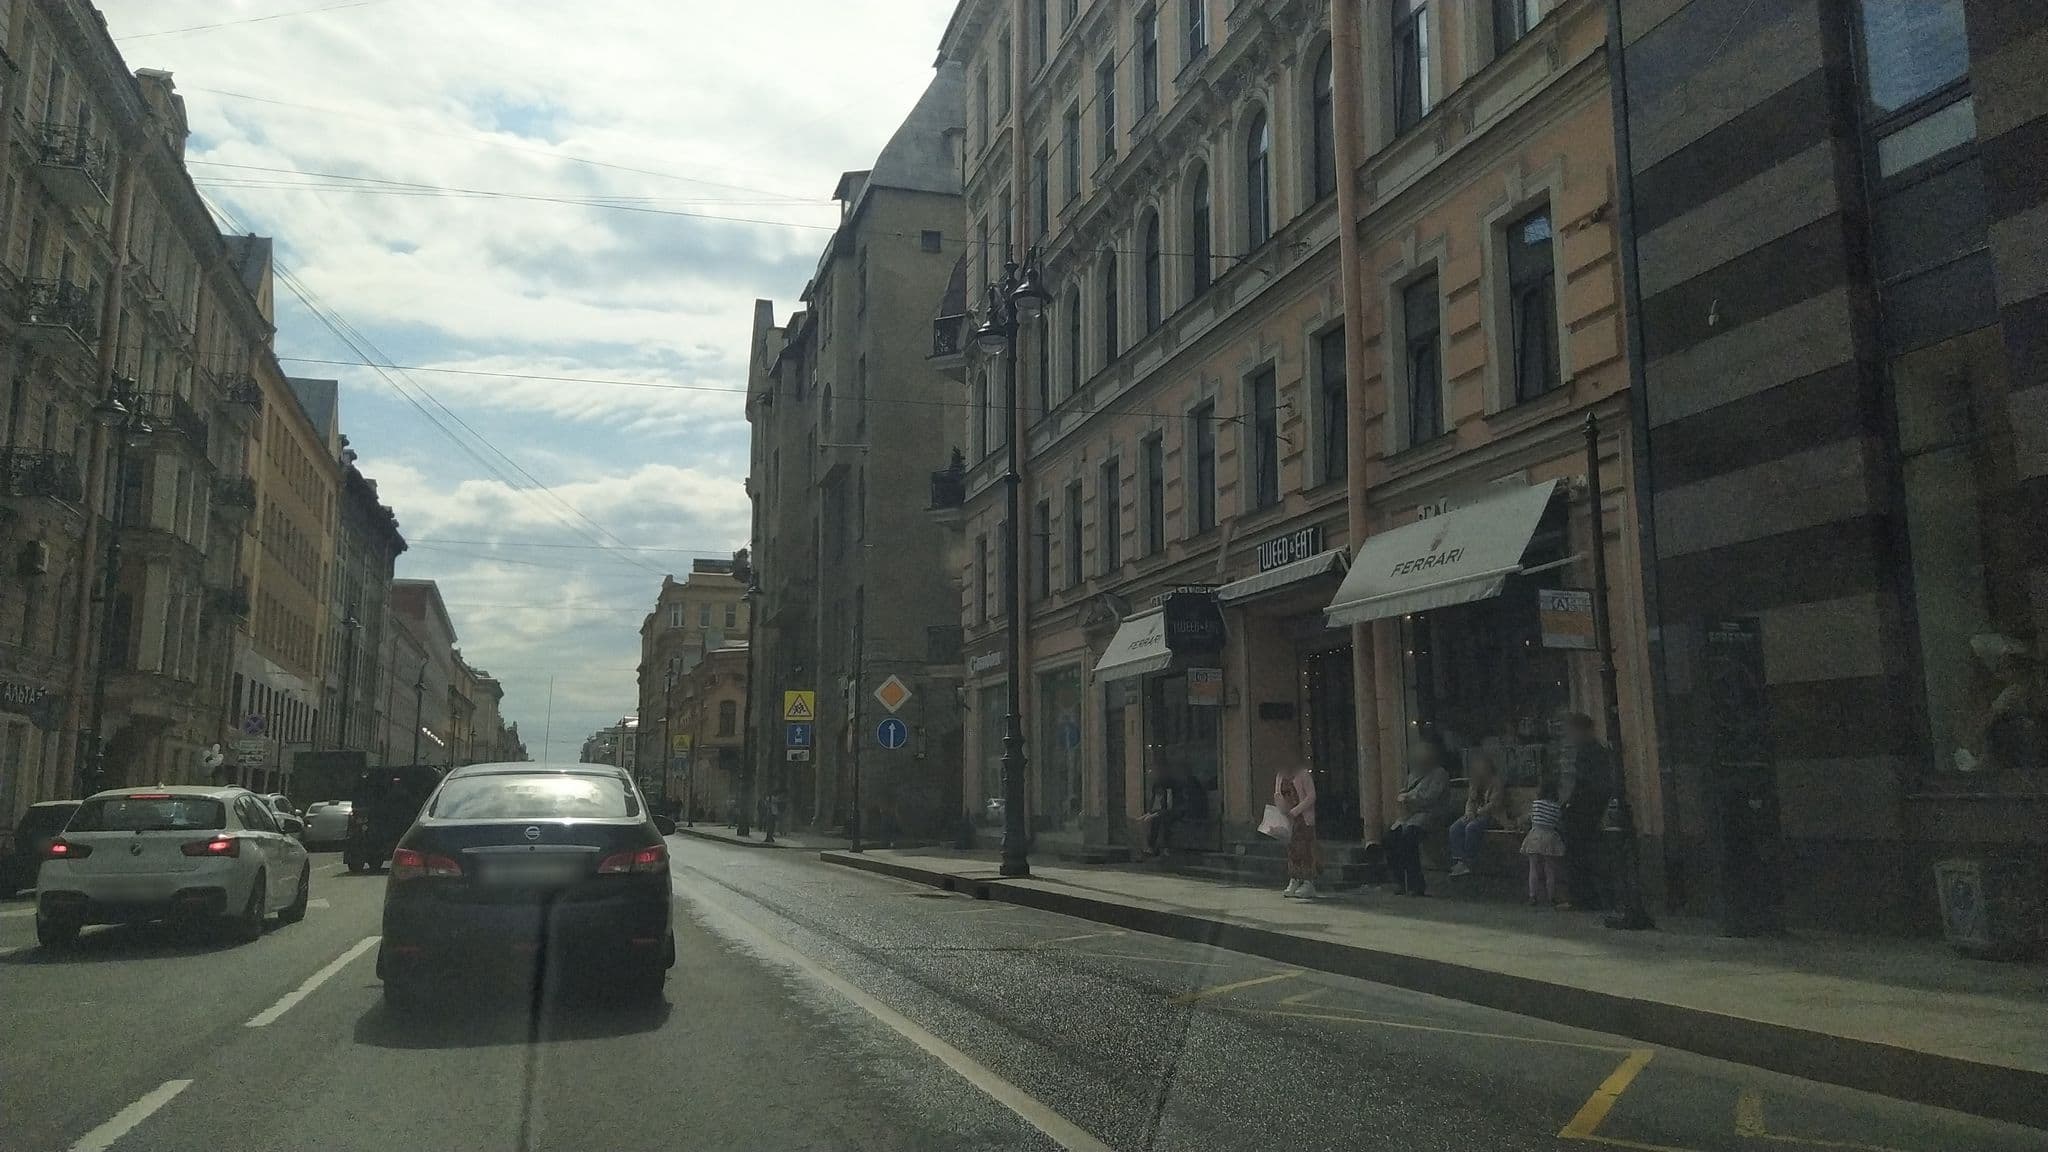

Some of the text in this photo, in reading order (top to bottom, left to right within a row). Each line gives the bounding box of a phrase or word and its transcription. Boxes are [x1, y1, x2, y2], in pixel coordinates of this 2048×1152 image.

[1256, 527, 1314, 574] TWEED & EAT
[1390, 547, 1465, 578] FERRARI
